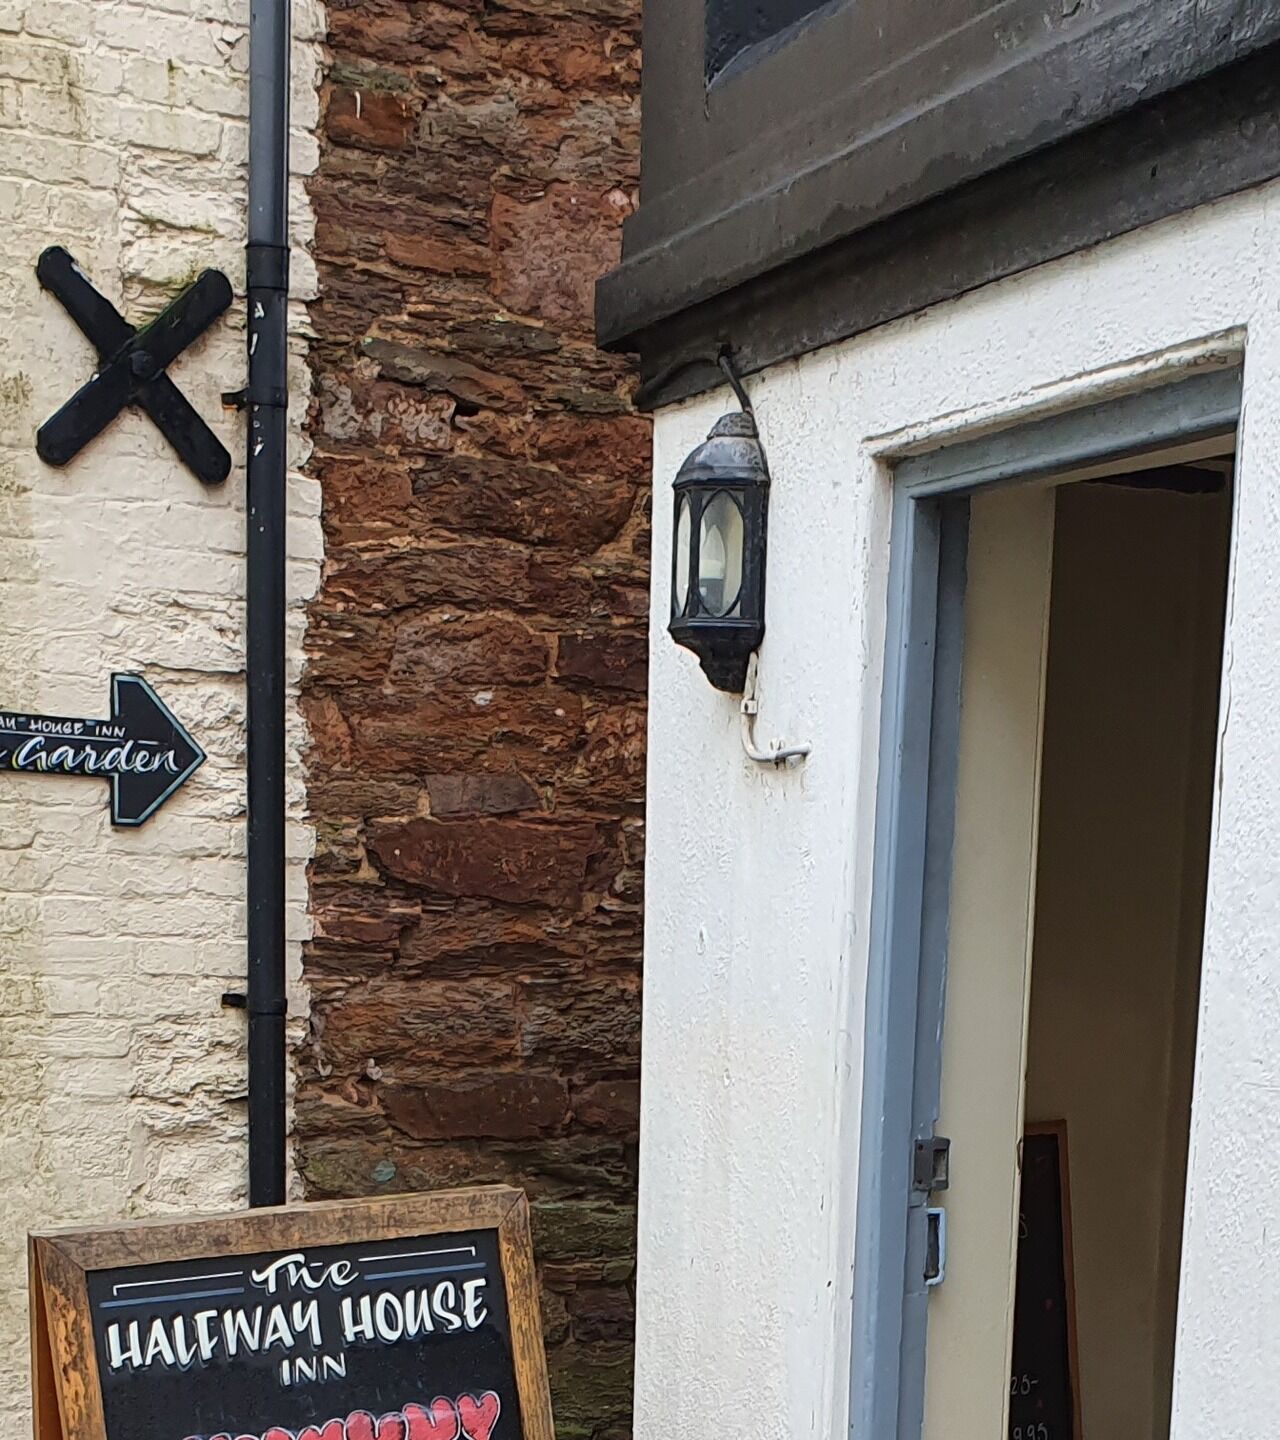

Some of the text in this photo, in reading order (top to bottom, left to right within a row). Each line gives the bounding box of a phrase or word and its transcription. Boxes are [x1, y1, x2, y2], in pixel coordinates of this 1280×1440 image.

[28, 718, 85, 736] HOUSE
[95, 725, 127, 739] INN
[13, 736, 180, 774] Garden
[251, 1253, 359, 1295] The
[107, 1278, 488, 1371] HALFWAY HOUSE
[280, 1352, 347, 1387] INN
